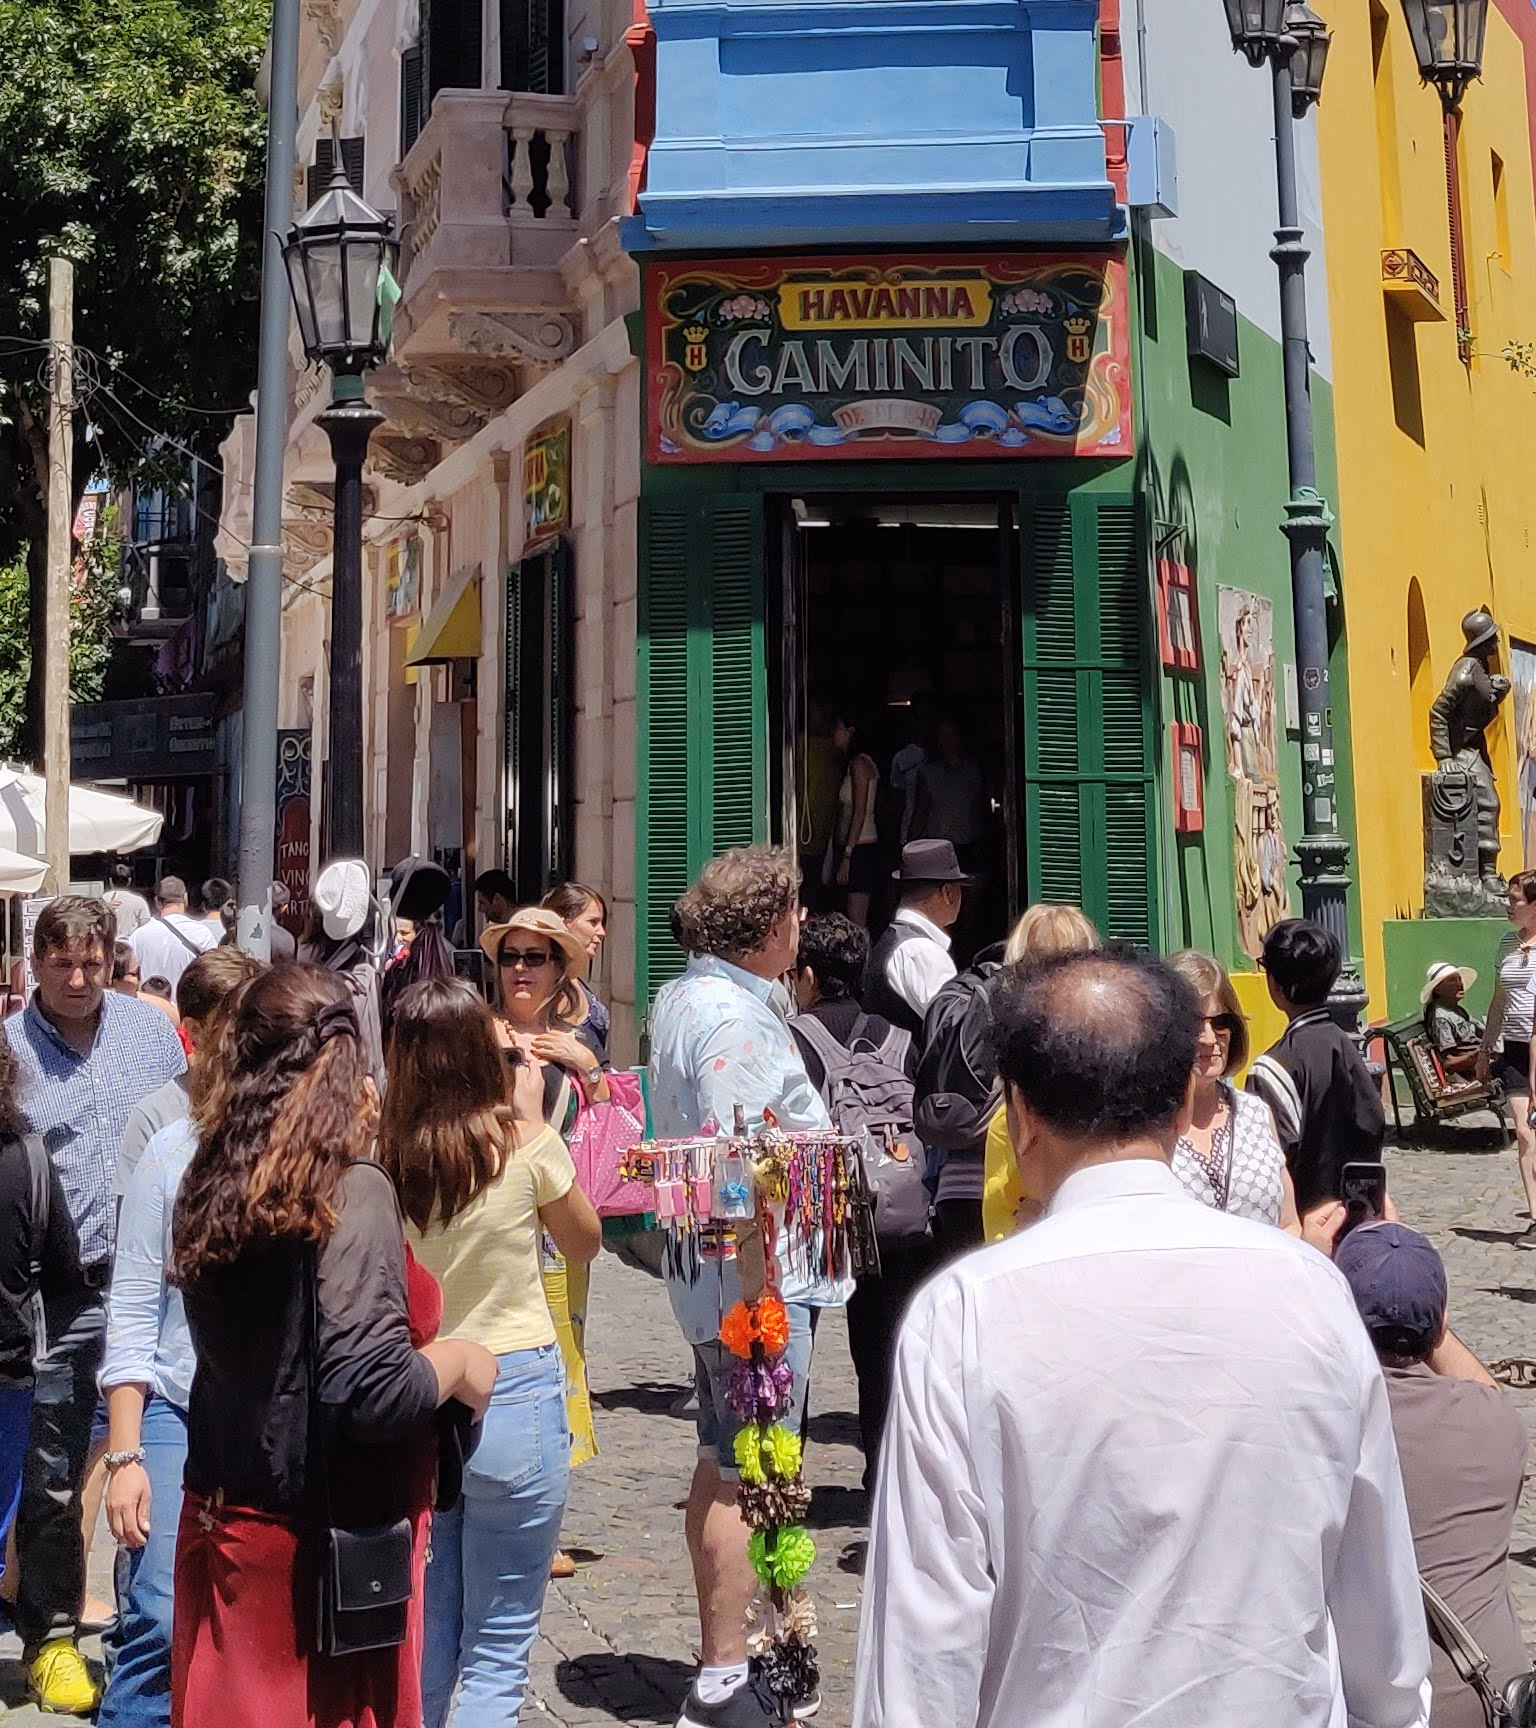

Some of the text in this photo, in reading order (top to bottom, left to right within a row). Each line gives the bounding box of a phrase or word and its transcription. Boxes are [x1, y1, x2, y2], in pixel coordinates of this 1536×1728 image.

[799, 287, 975, 322] HAVANNA
[690, 346, 703, 367] H
[1072, 338, 1085, 358] H
[724, 325, 1054, 396] CAMINITO
[280, 841, 309, 859] TANG
